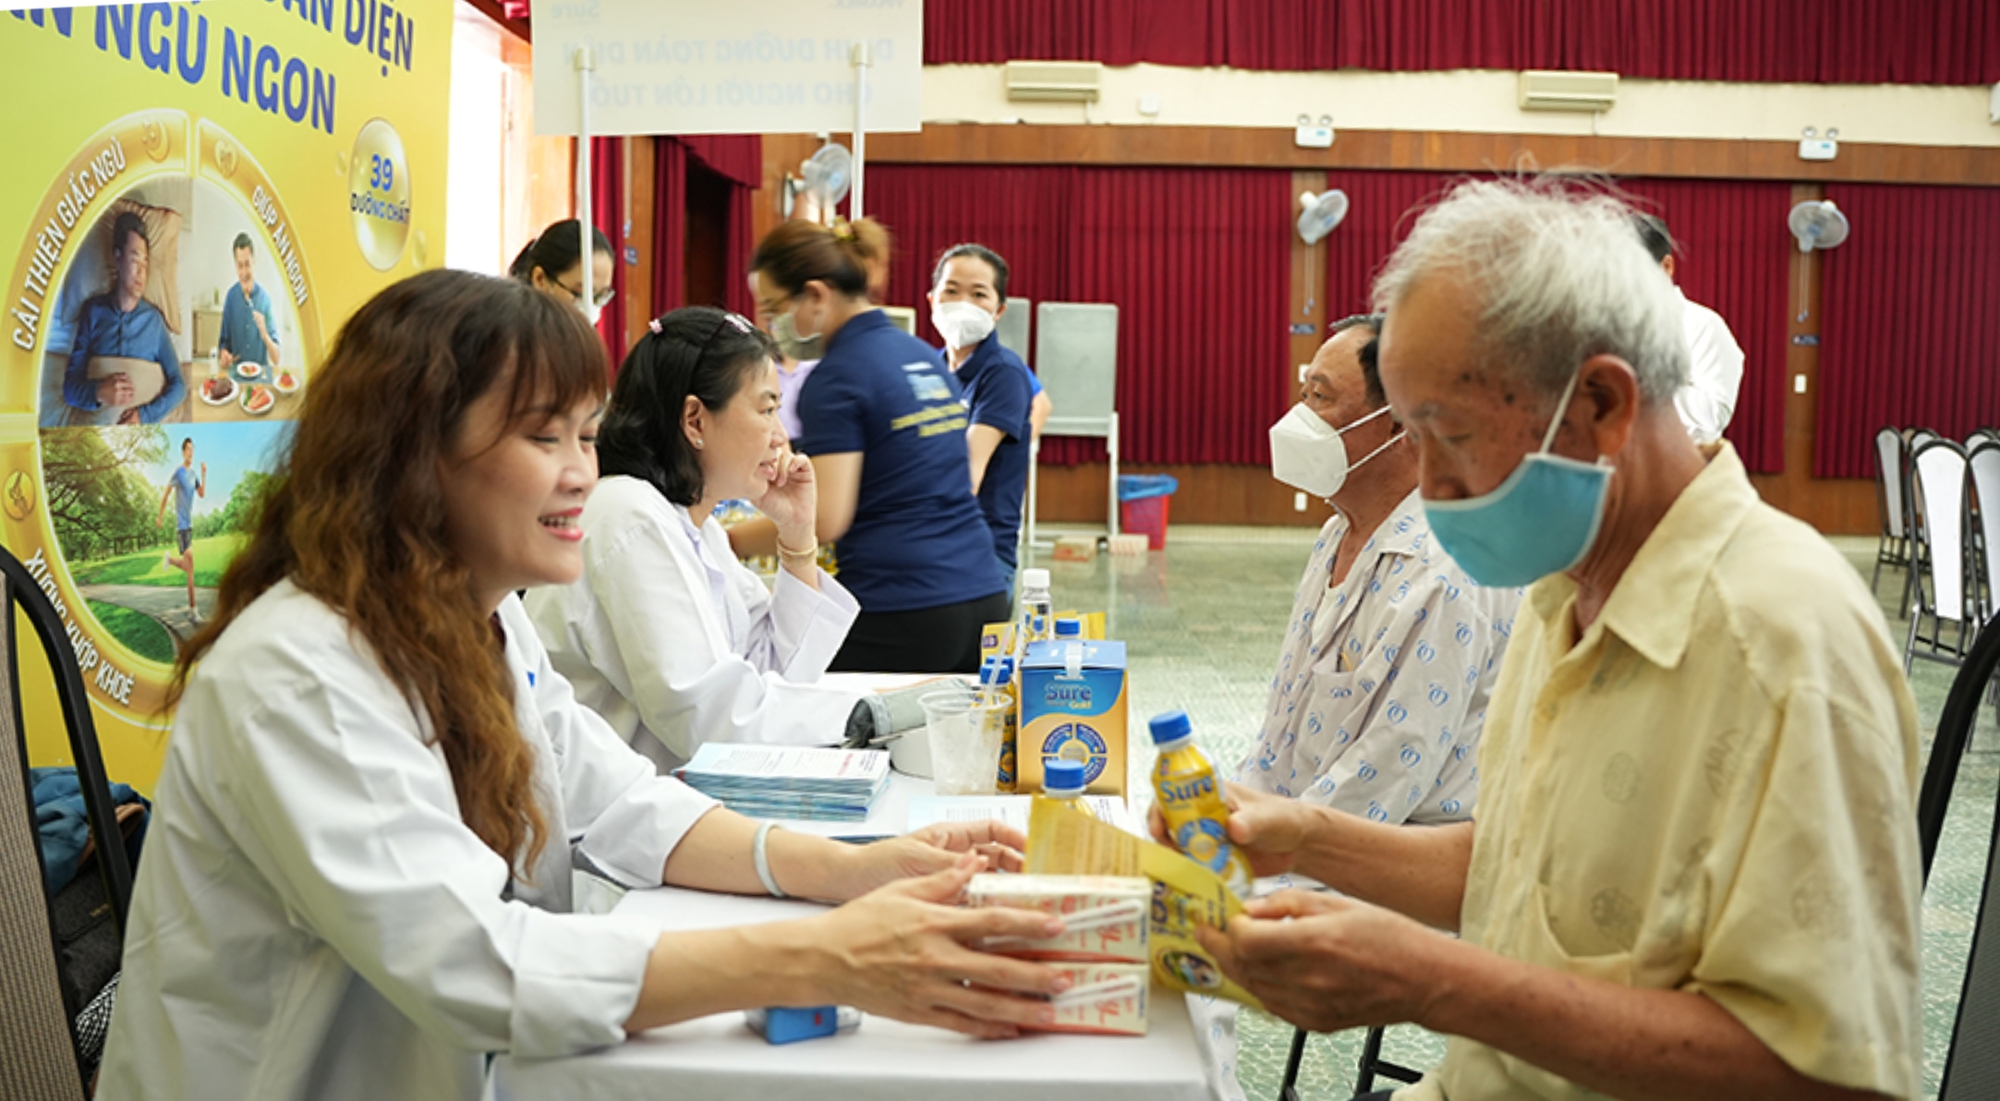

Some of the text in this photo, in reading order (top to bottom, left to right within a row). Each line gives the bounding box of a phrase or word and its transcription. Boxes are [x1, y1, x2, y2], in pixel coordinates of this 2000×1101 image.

[222, 26, 336, 135] NGON
[370, 153, 393, 192] 39
[24, 216, 68, 297] THIỆN
[1044, 682, 1092, 701] Sure
[1160, 775, 1213, 803] Sure
